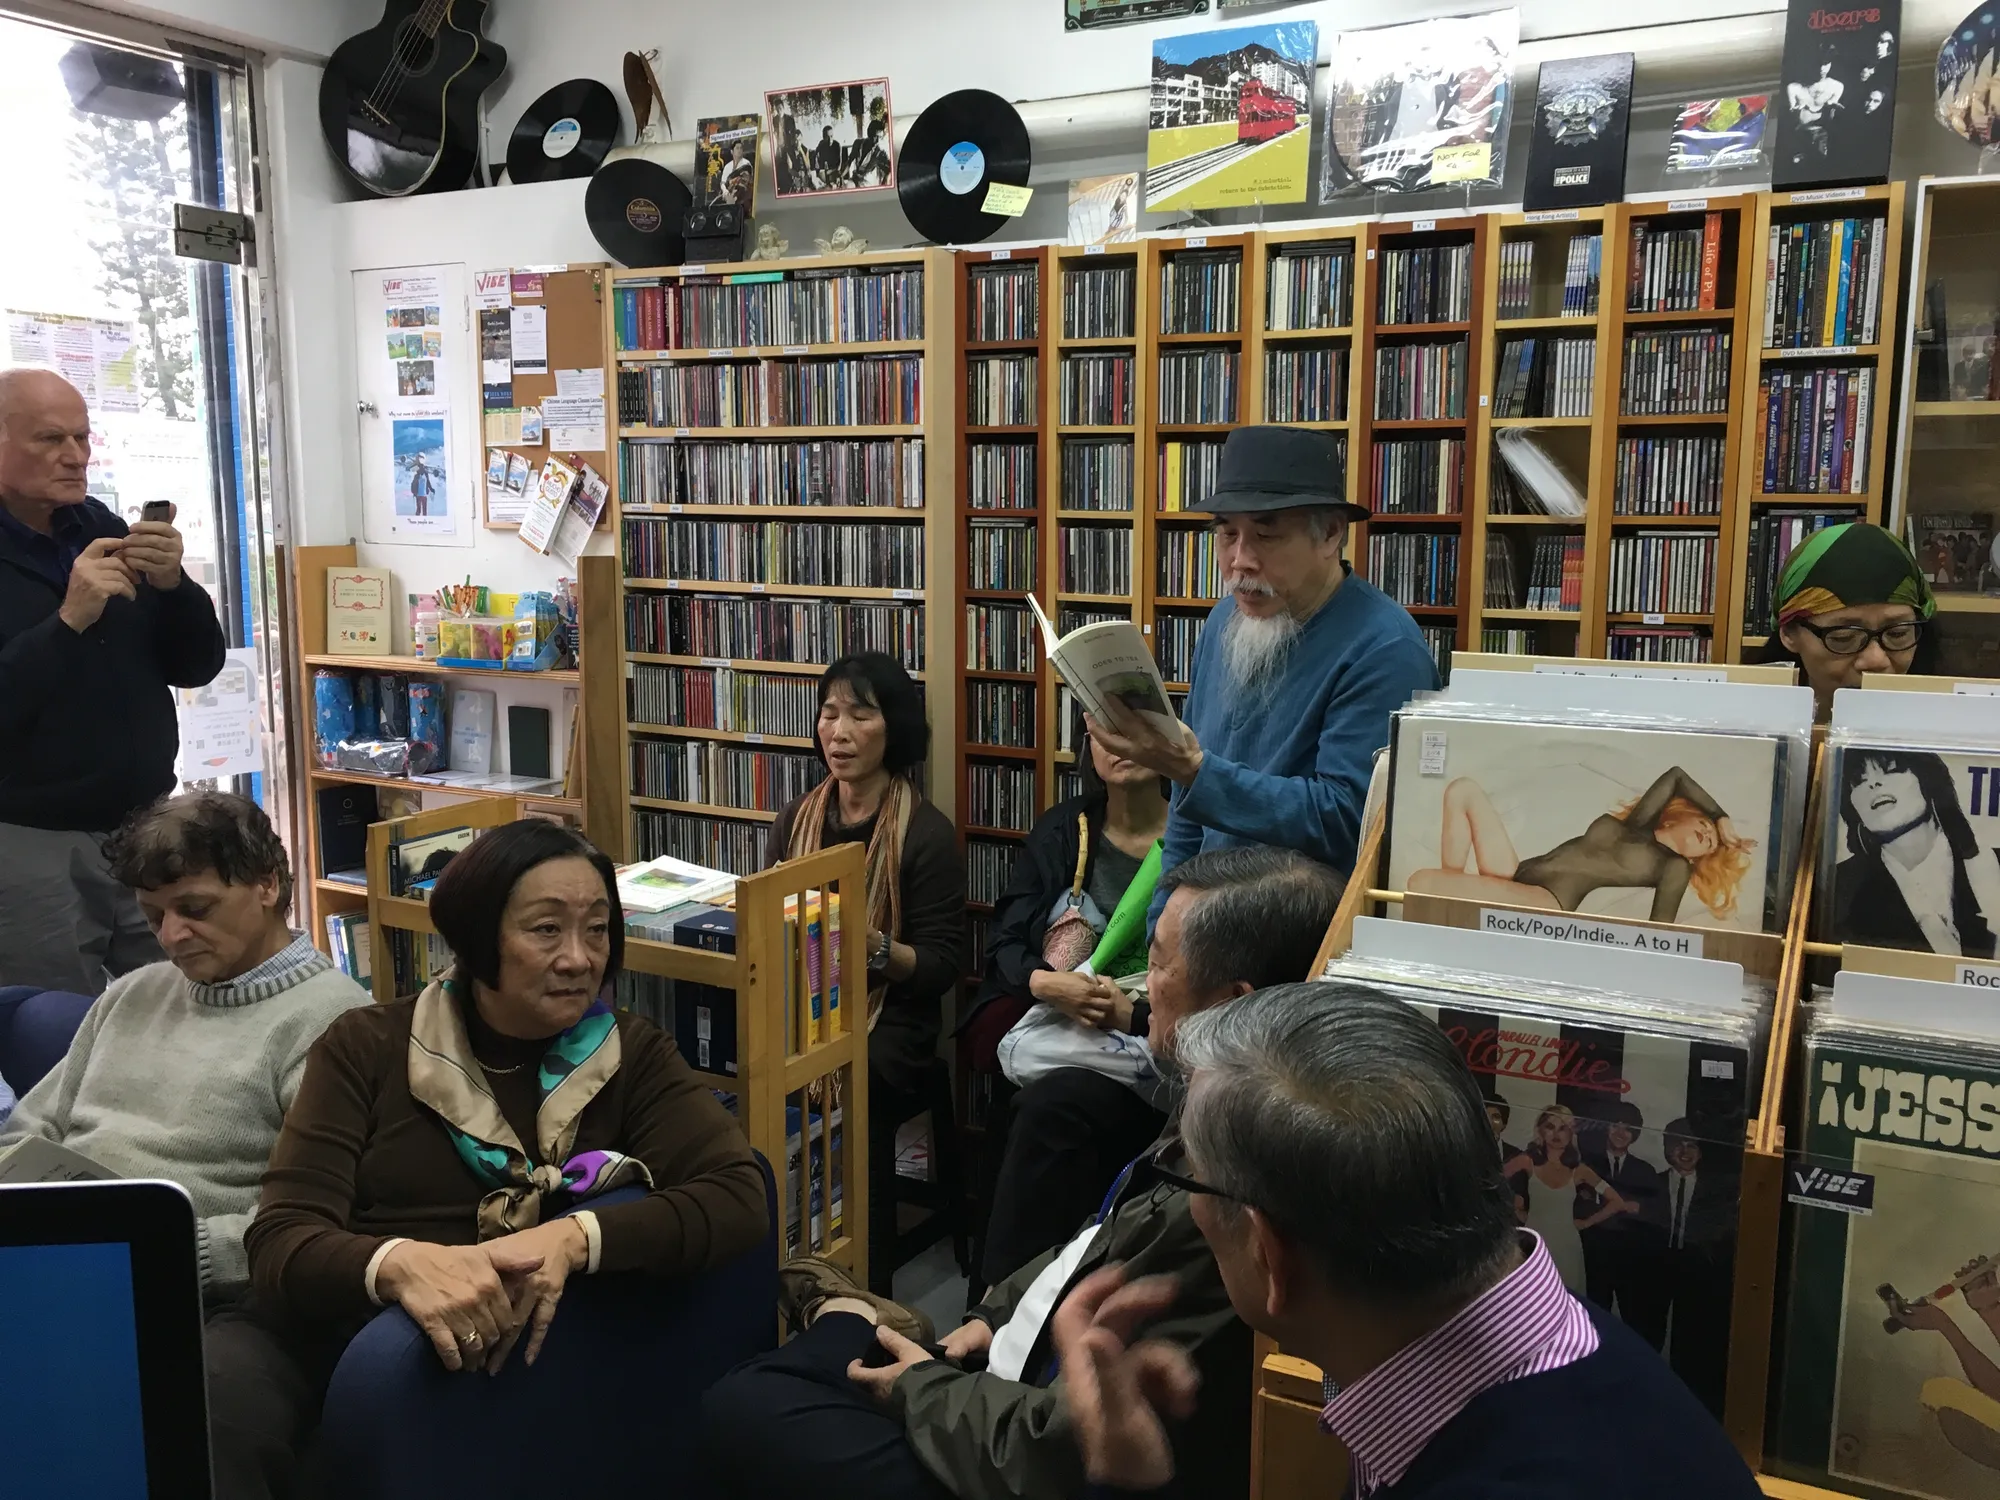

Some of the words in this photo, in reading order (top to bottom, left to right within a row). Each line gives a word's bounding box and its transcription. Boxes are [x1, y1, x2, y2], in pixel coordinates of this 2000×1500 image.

[1437, 152, 1458, 161] NOT
[1462, 148, 1481, 157] FOR
[1560, 174, 1588, 184] POLICE
[1705, 242, 1716, 263] Life
[1704, 267, 1713, 276] of
[384, 280, 402, 293] VIBE
[477, 273, 506, 293] VIBE
[1703, 280, 1713, 292] Pi
[1858, 395, 1867, 428] POLICE
[1092, 659, 1112, 670] ODES
[404, 871, 431, 885] MICHAEL
[1486, 914, 1629, 946] Rock/Pop/Indie...
[1634, 933, 1647, 948] A
[1652, 936, 1670, 951] to
[1676, 939, 1689, 953] H
[1498, 1030, 1540, 1047] PARALLEL
[1794, 1167, 1866, 1196] VIBE
